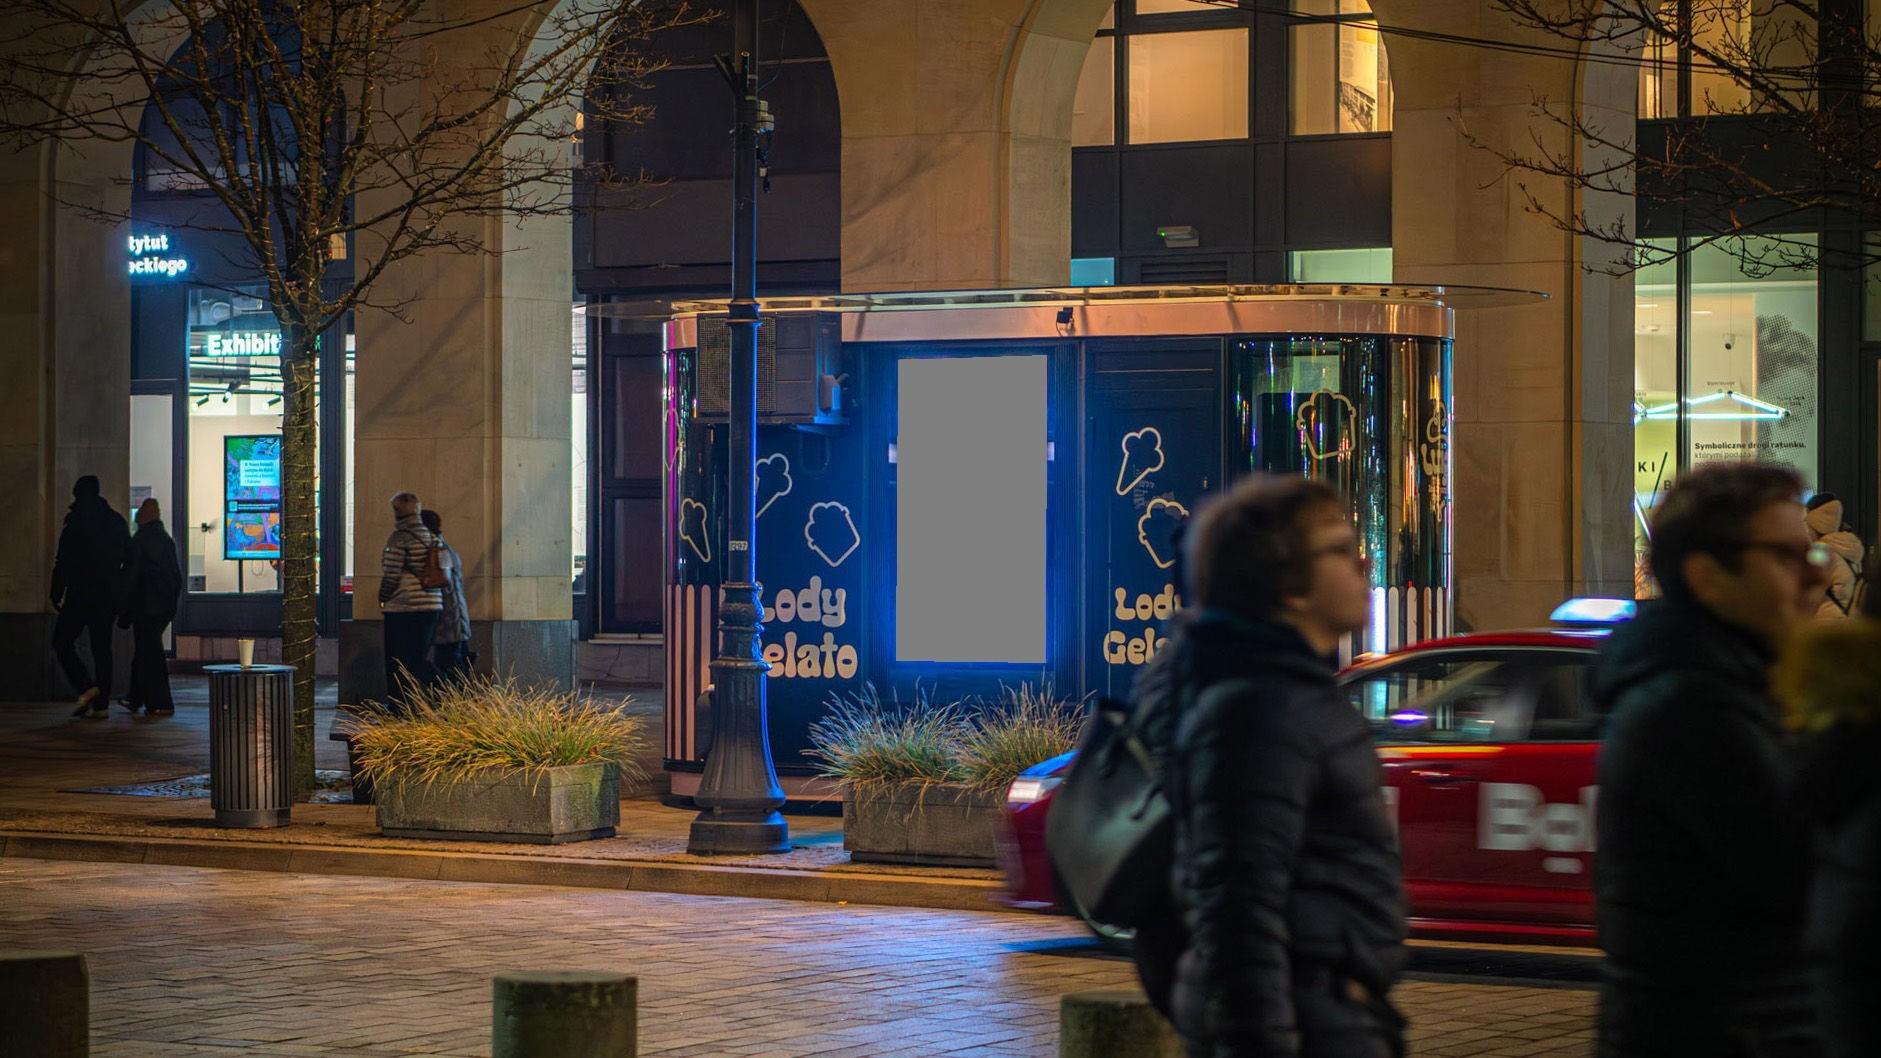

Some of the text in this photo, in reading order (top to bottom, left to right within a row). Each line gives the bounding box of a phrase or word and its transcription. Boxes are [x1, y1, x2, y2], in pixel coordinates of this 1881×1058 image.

[207, 332, 282, 355] Exhibit
[1695, 442, 1746, 450] Symboliczne
[758, 632, 858, 679] elato
[1103, 627, 1169, 665] Gel
